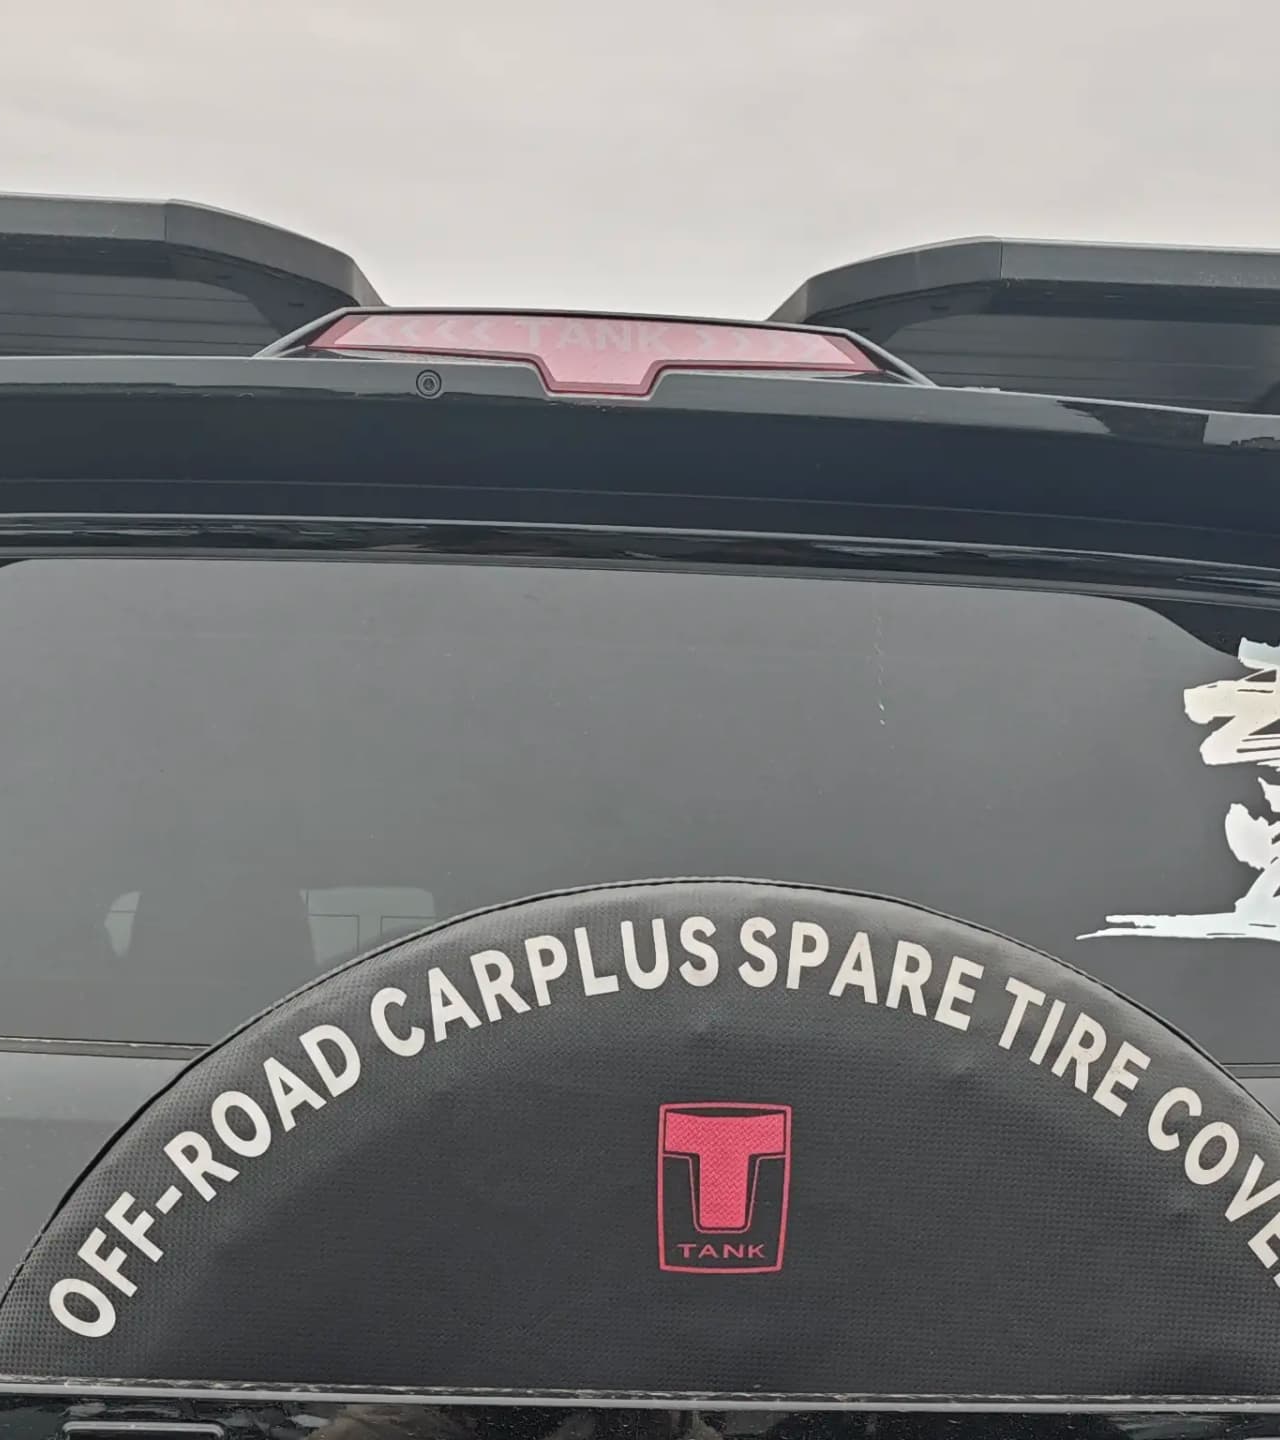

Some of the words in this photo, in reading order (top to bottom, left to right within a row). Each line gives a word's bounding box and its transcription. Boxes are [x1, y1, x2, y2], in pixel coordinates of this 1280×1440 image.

[514, 320, 673, 354] TANK
[48, 1023, 362, 1339] OFF-ROAD
[369, 915, 720, 1058] CARPLUS
[738, 916, 986, 1032] SPARE
[998, 976, 1151, 1117] TIRE
[676, 1243, 766, 1259] TANK
